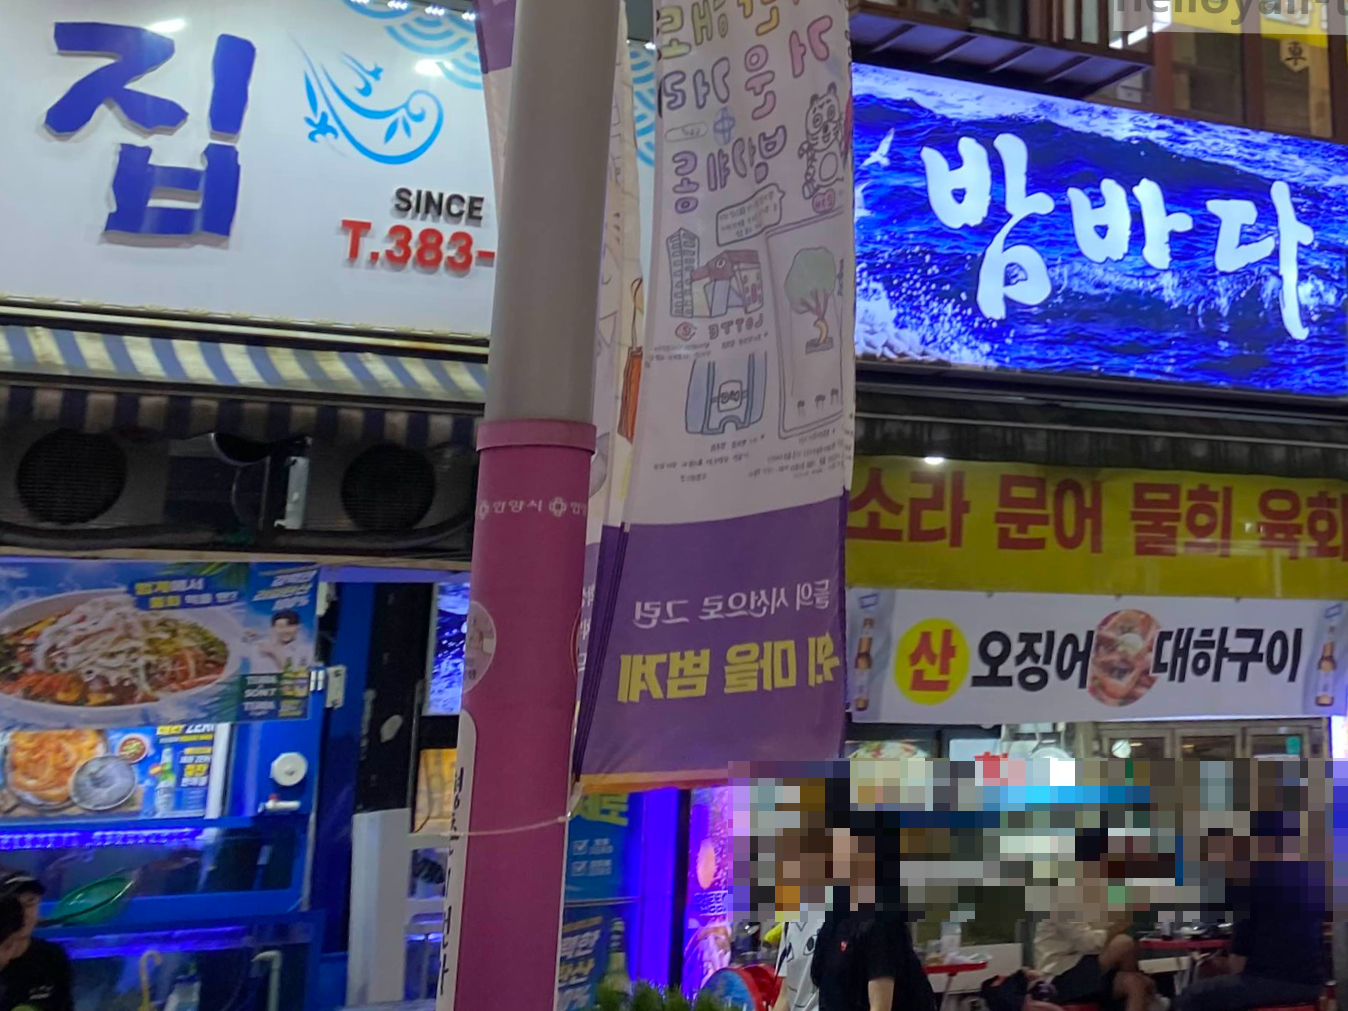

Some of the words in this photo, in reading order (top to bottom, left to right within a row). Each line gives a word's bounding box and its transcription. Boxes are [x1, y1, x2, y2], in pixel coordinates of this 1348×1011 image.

[44, 21, 257, 237] 집
[394, 188, 485, 222] SINCE
[921, 133, 1314, 341] 밤바다
[846, 469, 970, 548] 소라
[995, 474, 1103, 554] 문어
[908, 629, 957, 693] 산
[970, 629, 1093, 691] 오징어
[1152, 626, 1304, 684] 대하구이
